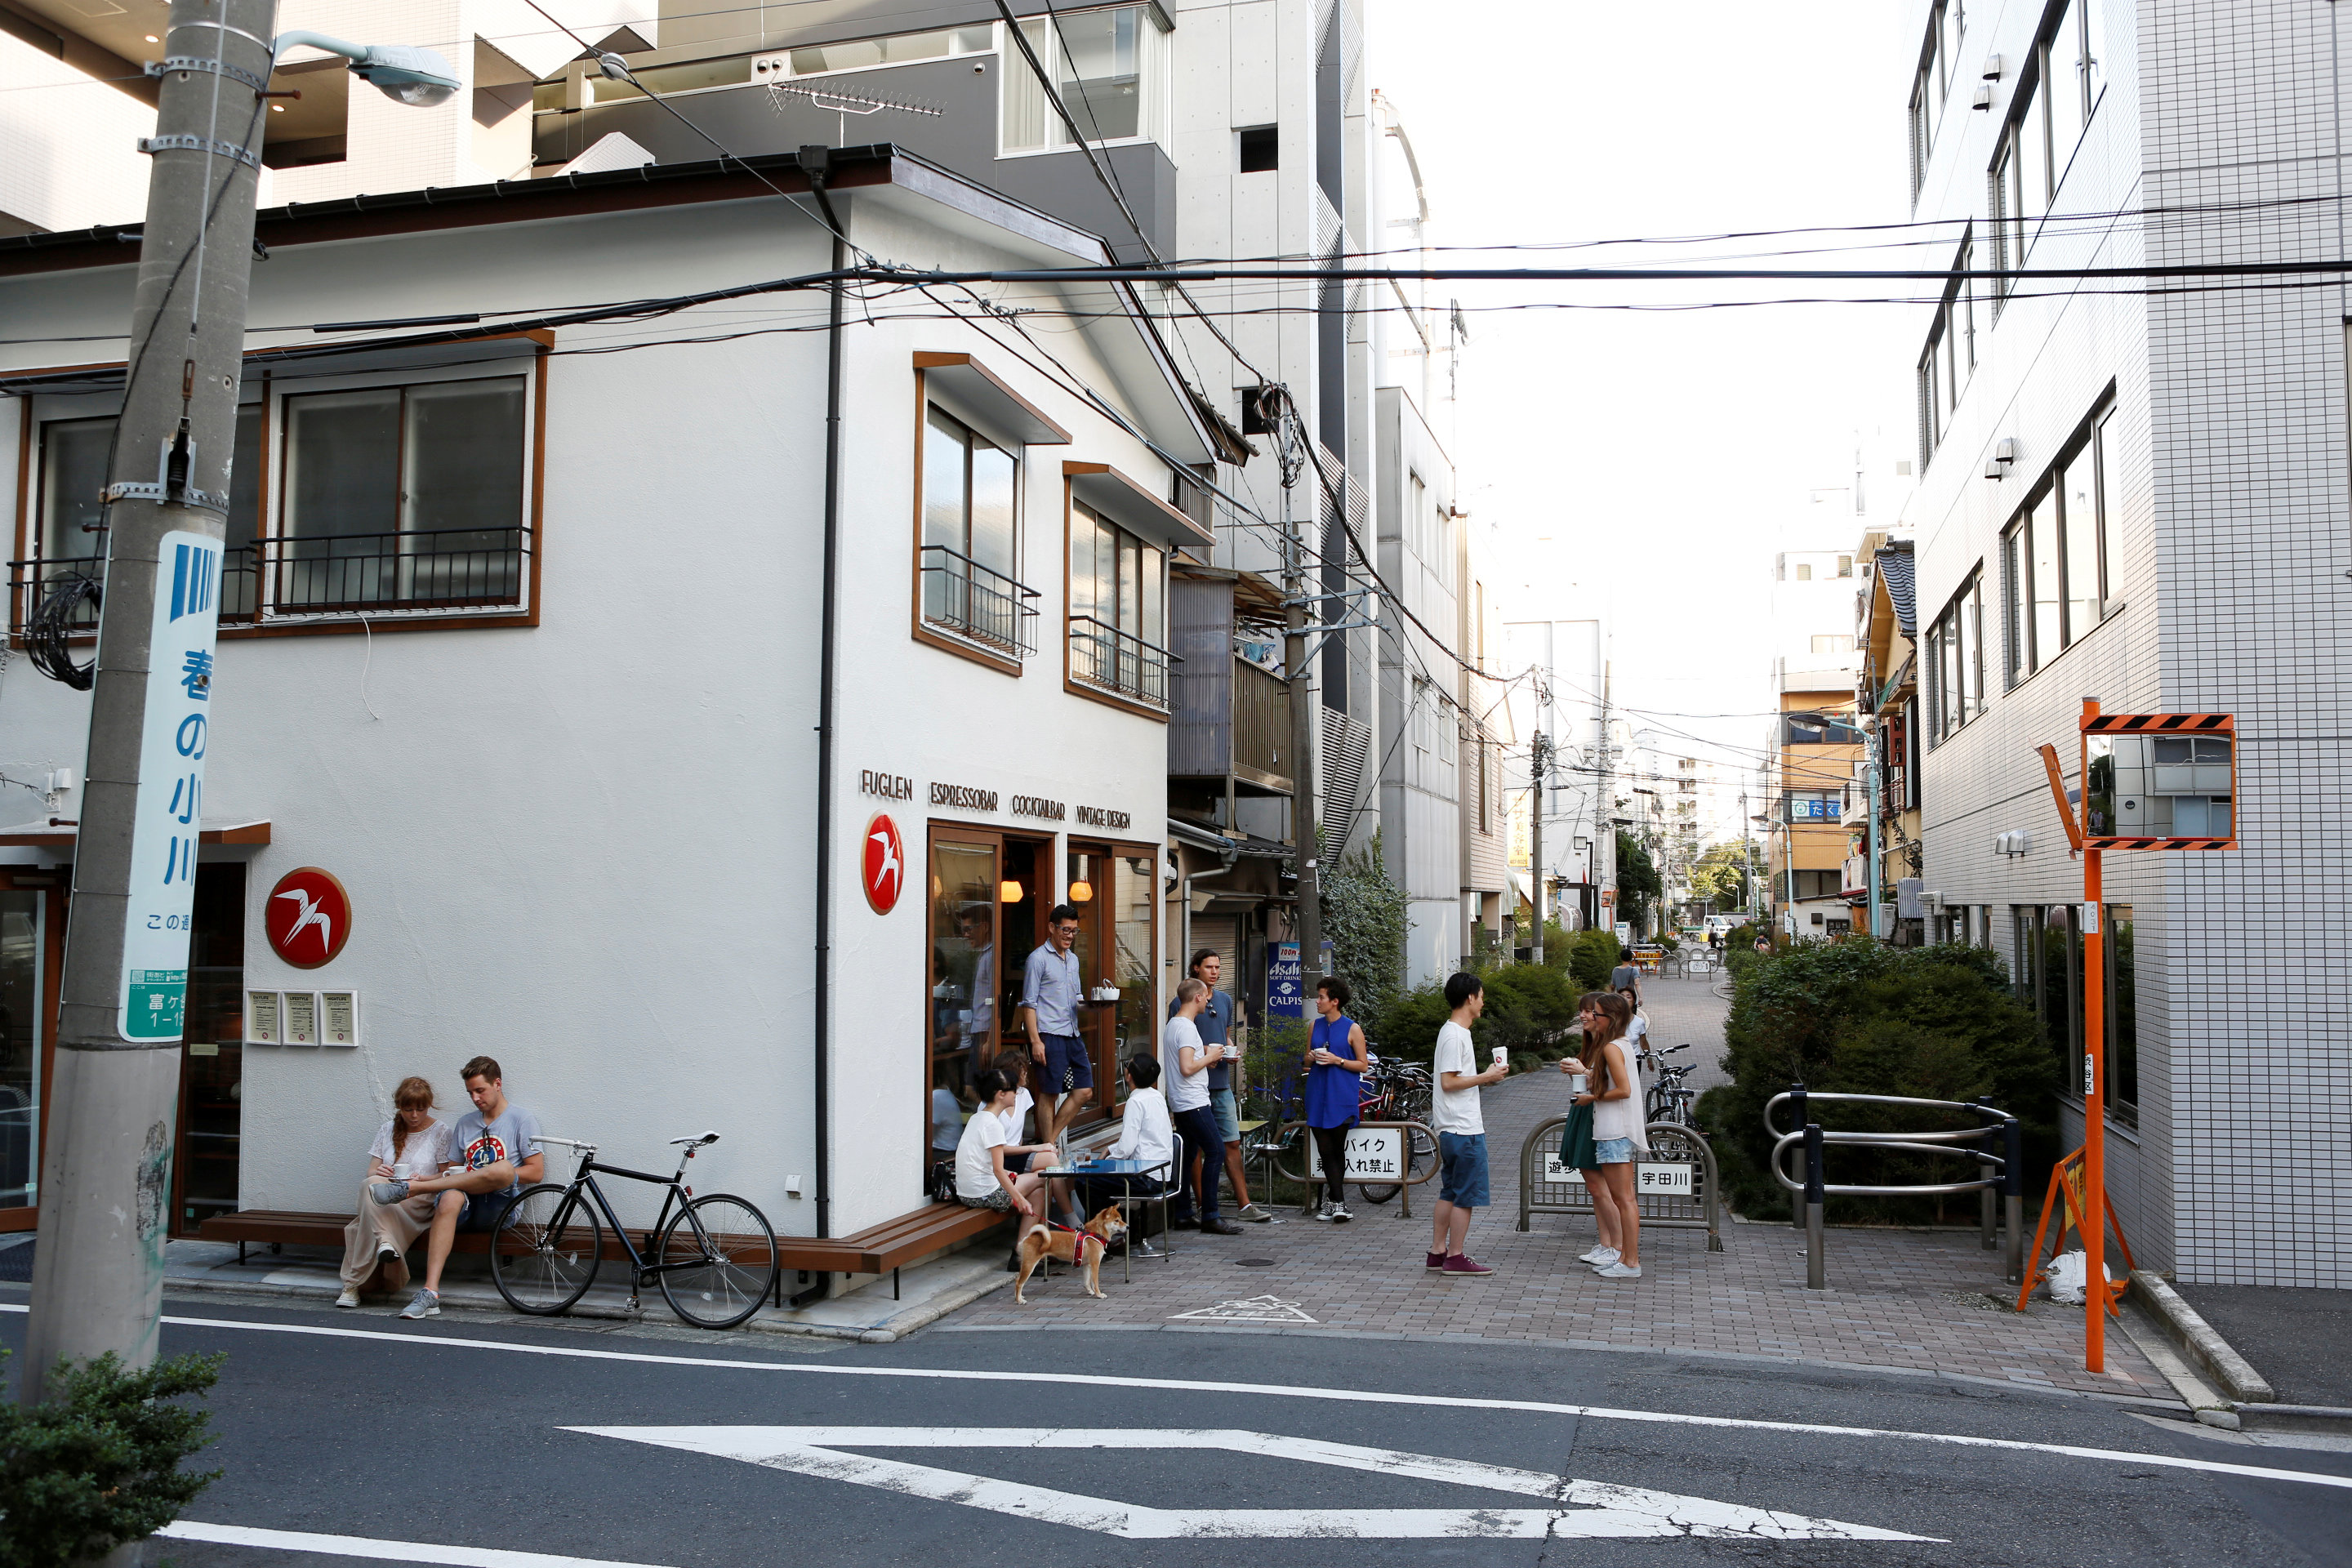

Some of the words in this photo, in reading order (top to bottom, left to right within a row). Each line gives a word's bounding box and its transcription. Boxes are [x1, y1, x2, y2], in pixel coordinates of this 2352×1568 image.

[164, 649, 214, 886] 春の小川
[862, 769, 913, 802] FUGLEN
[930, 782, 998, 812] ESPRESSOBAR
[1012, 795, 1066, 822] COCKTAILBAR
[1076, 805, 1106, 826] VINTAGE
[1107, 809, 1131, 829] DESIGN
[1812, 805, 1842, 816] たく
[1269, 996, 1303, 1006] CALPIS
[1642, 1172, 1688, 1186] 宇田川
